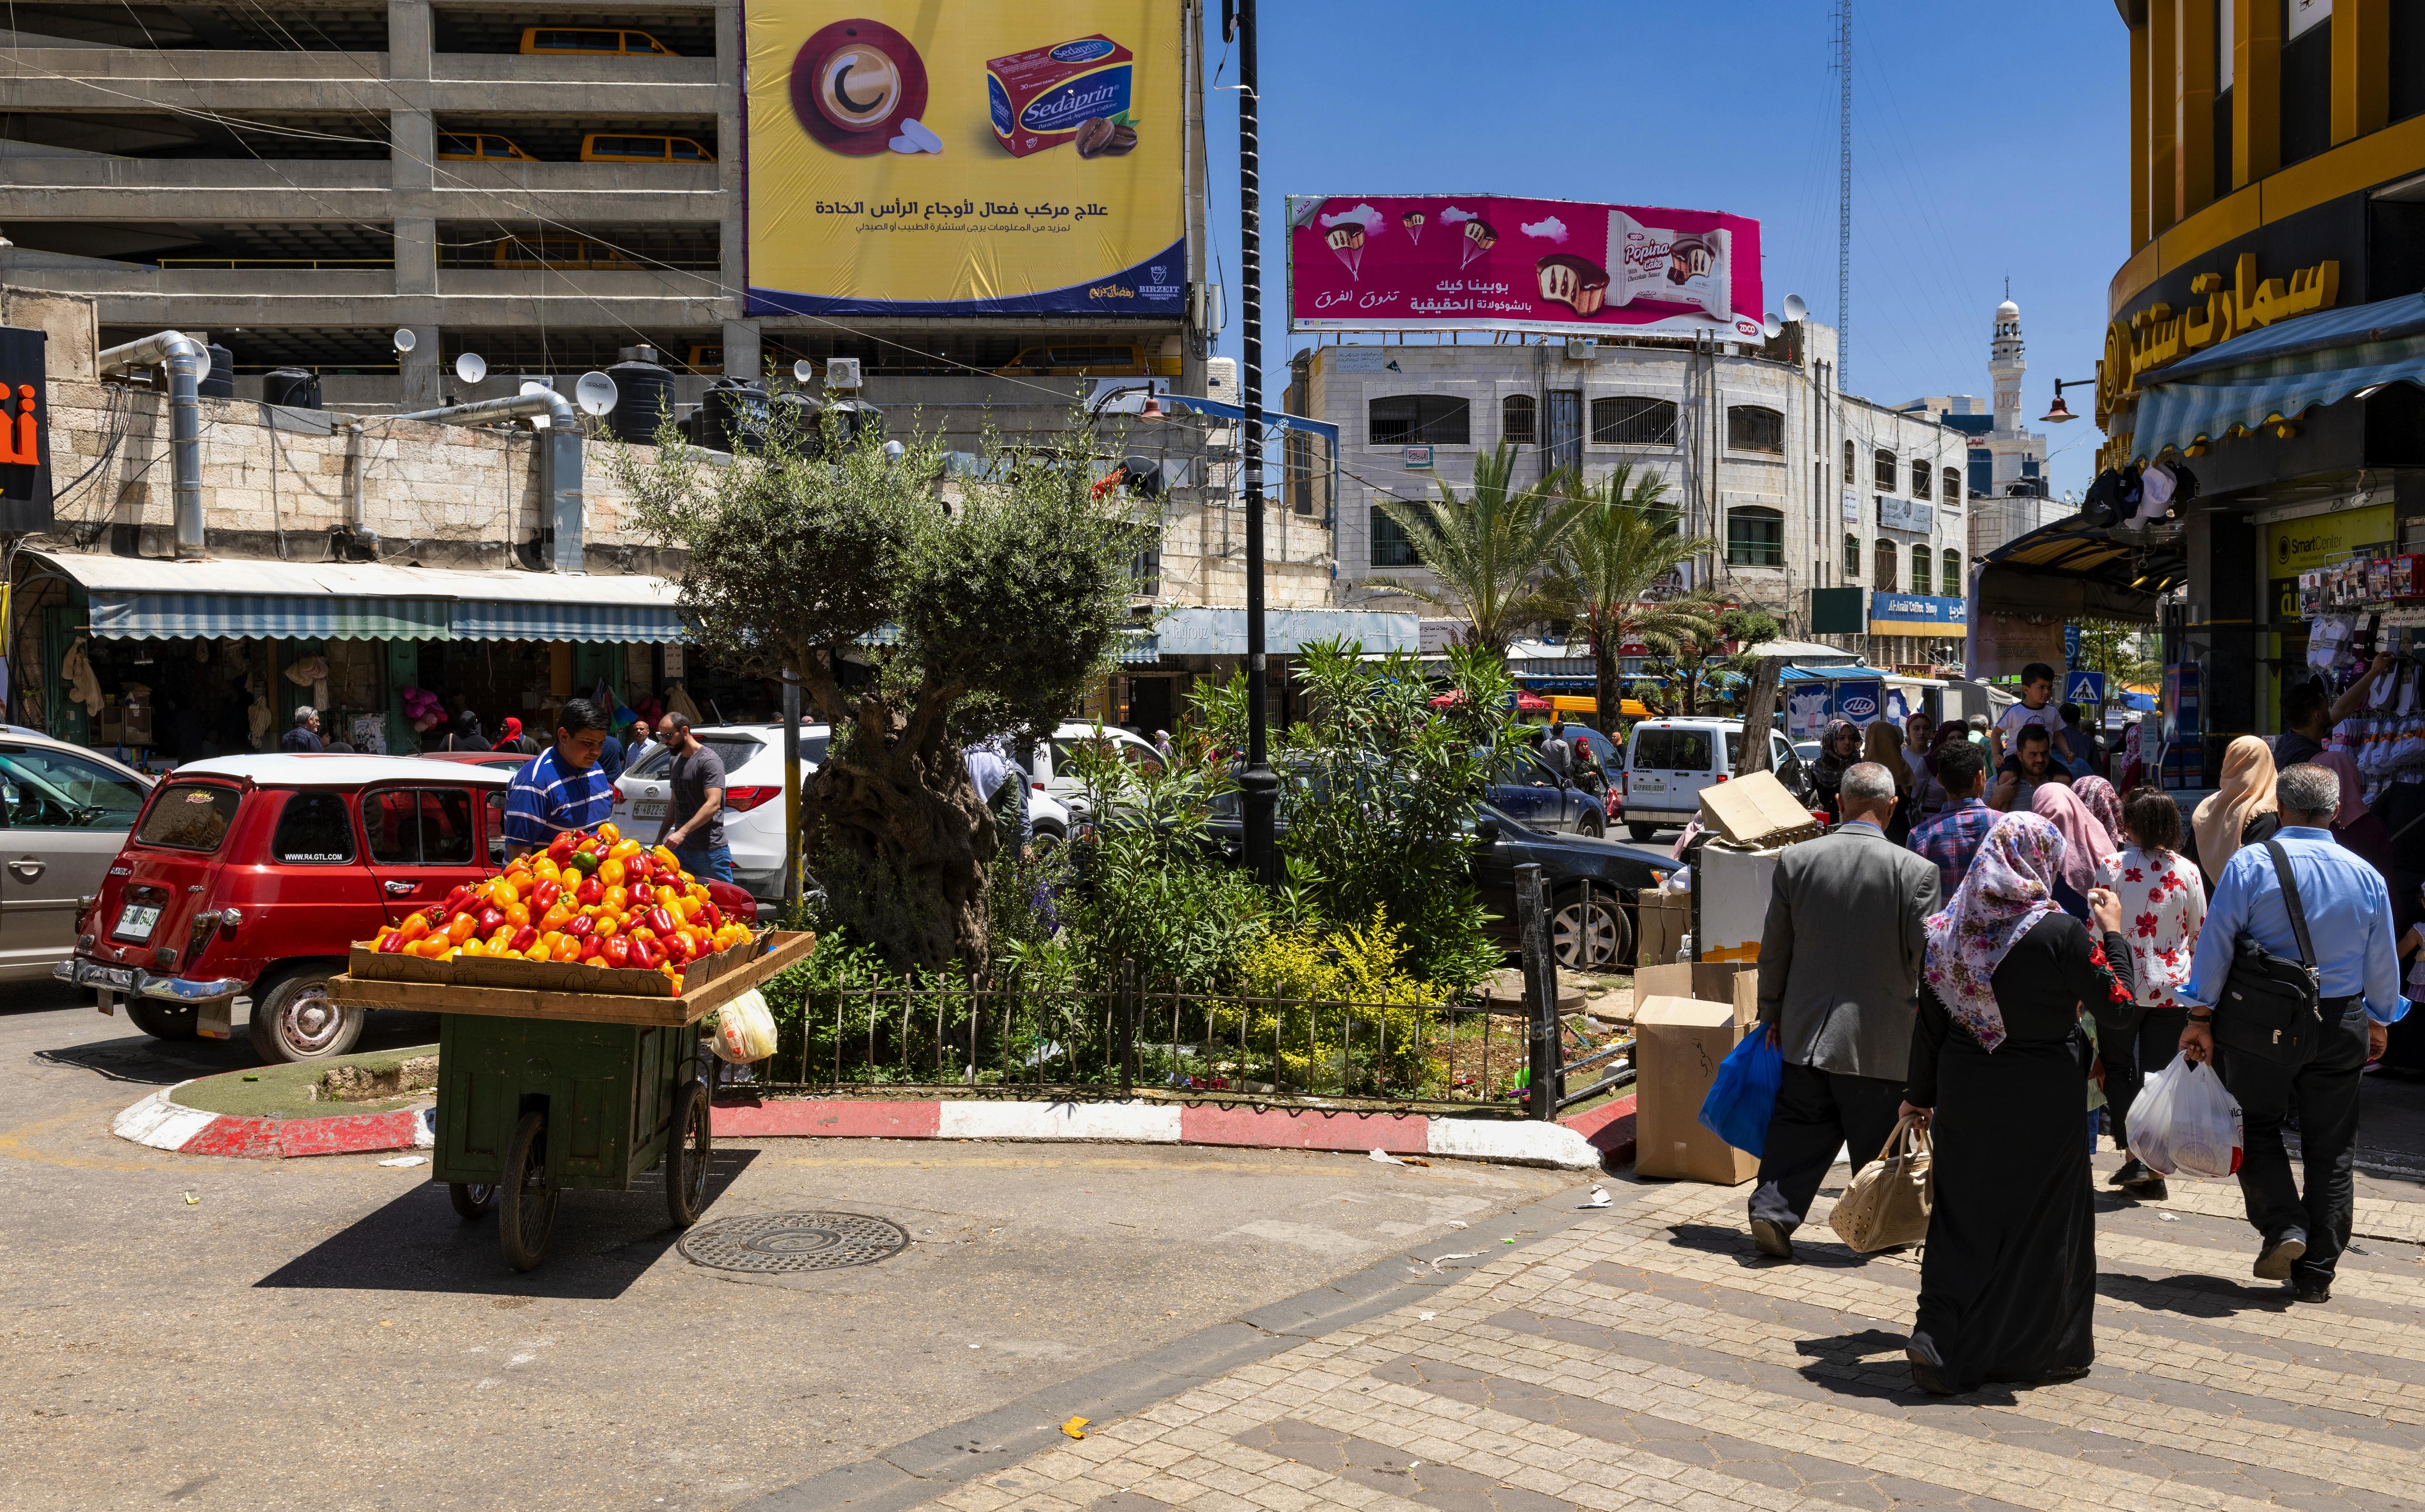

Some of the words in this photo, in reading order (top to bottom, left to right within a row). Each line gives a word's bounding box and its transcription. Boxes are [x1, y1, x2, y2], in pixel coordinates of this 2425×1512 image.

[1038, 115, 1072, 129] Paracetamol,
[1073, 110, 1091, 120] Aspirin
[1097, 102, 1117, 112] Caffeine
[815, 201, 863, 214] الحادة
[870, 199, 918, 218] الرأس
[923, 198, 974, 220] لأوجاع
[979, 202, 1019, 218] فعال
[1024, 202, 1069, 218] مركب
[1074, 203, 1109, 221] علاج
[1296, 200, 1311, 214] جديد
[855, 223, 888, 234] الصيدلي
[889, 222, 897, 232] أو
[898, 223, 929, 232] الطبيب
[930, 223, 966, 232] استشارة
[967, 224, 986, 233] يرجى
[987, 223, 1030, 232] المعلومات
[1032, 224, 1046, 233] من
[1048, 223, 1070, 232] لمزيد
[1625, 239, 1670, 265] Popina
[1644, 258, 1664, 271] Cake
[1628, 273, 1647, 282] Chocolate
[1436, 280, 1463, 291] كيك
[1468, 279, 1509, 295] بوبينا
[1315, 290, 1353, 308] الفرق
[1359, 290, 1400, 308] تذوق
[1410, 296, 1473, 314] الحقيقية
[2184, 253, 2340, 347] سمارت
[1477, 300, 1532, 314] بالشوكولاتة
[1739, 323, 1757, 334] ZDCO
[1888, 600, 1908, 612] Al-Arabi
[1909, 601, 1924, 613] Coffee
[1925, 602, 1938, 615] Shop
